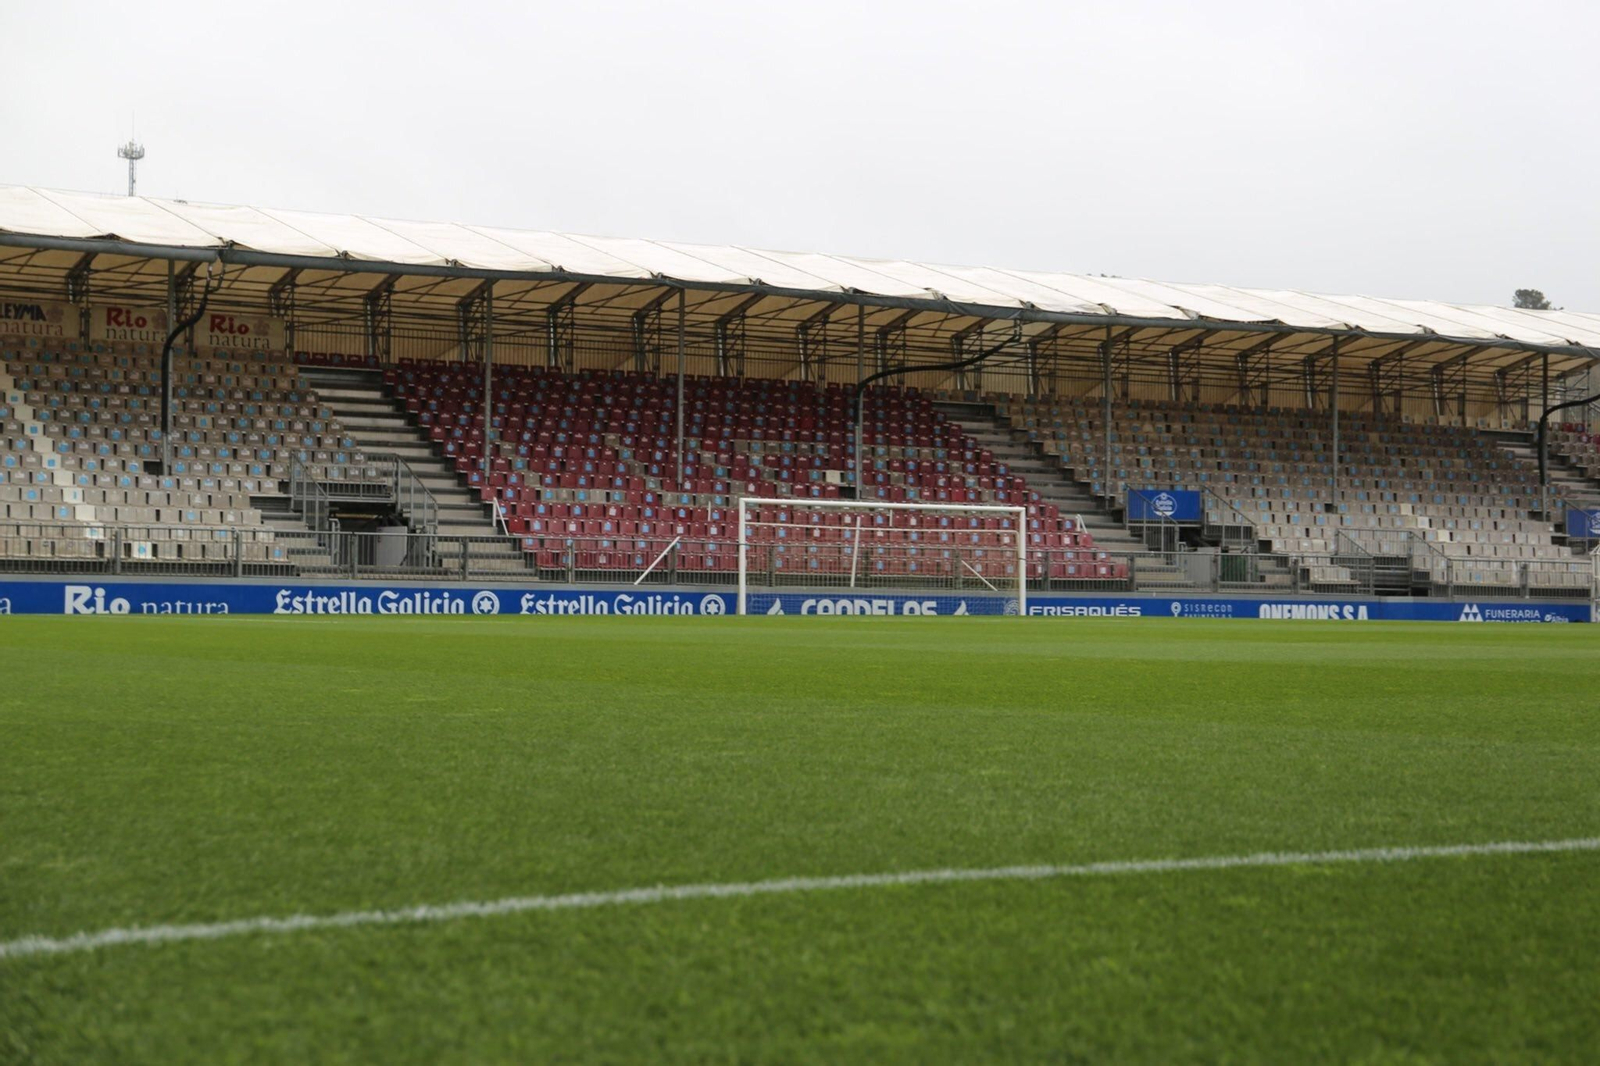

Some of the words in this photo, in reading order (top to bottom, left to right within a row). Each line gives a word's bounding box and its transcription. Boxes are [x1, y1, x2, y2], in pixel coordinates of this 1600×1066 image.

[106, 307, 147, 328] Rio
[209, 314, 250, 335] Rio
[209, 334, 270, 349] natura
[64, 584, 130, 614] Rio
[141, 599, 229, 614] natura
[273, 589, 372, 614] Estrella
[377, 590, 465, 614] Galicia
[520, 592, 608, 615] Estrella
[613, 594, 693, 615] Galicia
[1029, 603, 1142, 616] FRISAQUÉS
[1485, 609, 1541, 619] FUNERARIA
